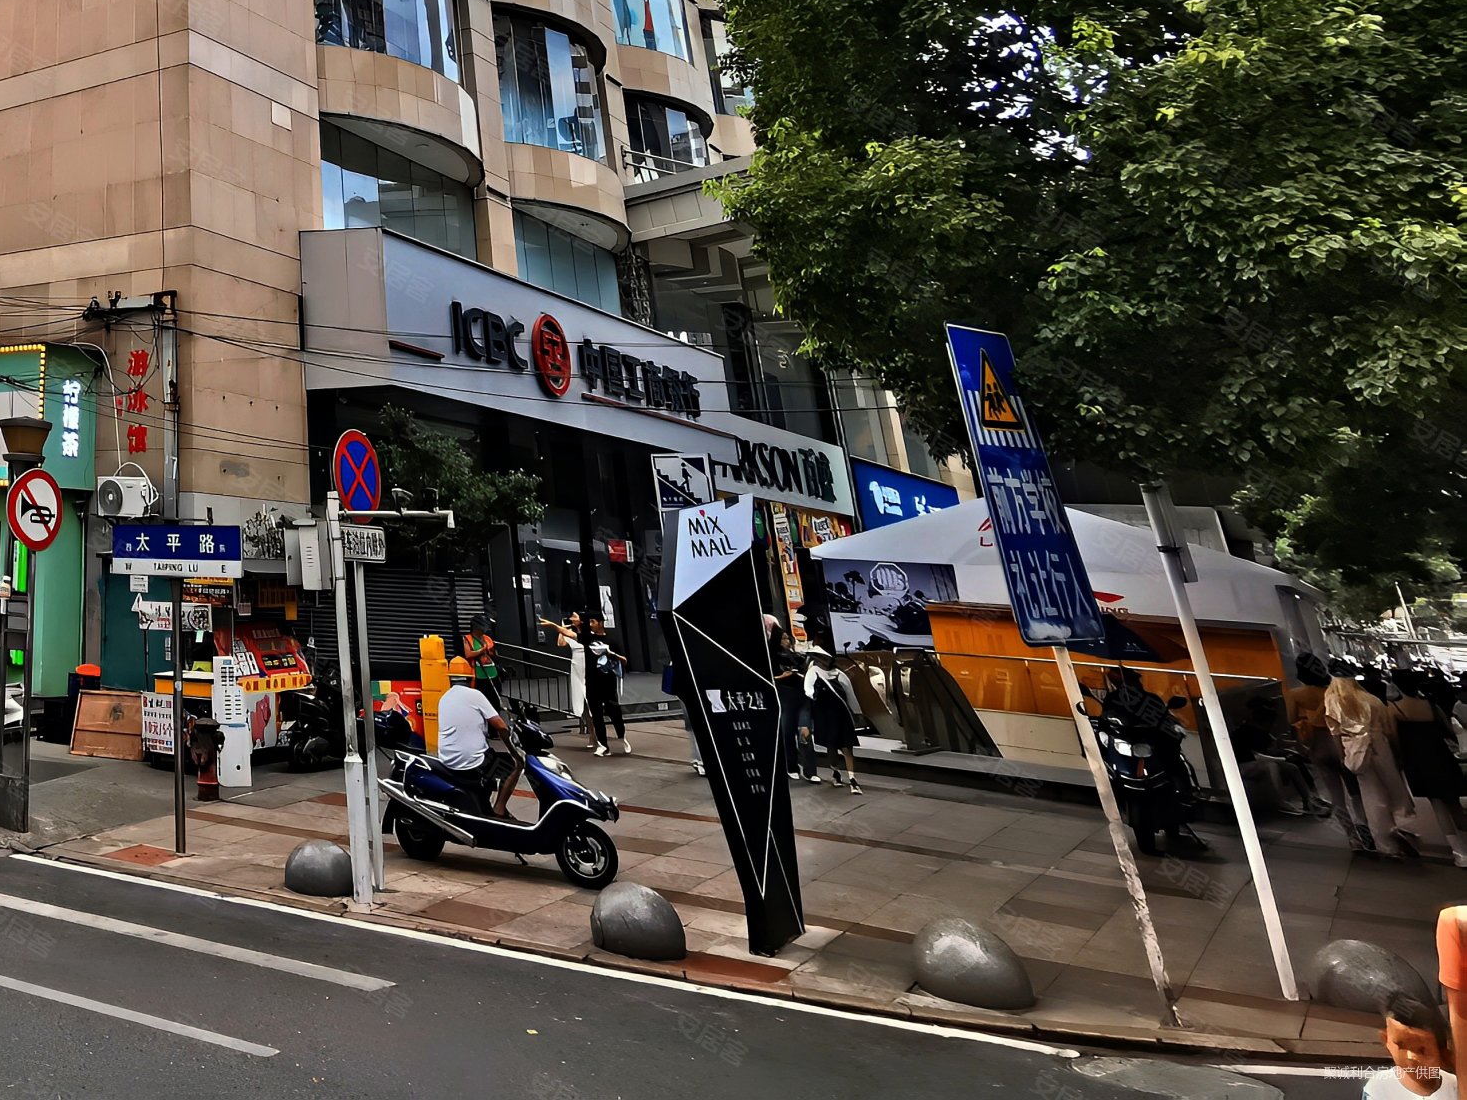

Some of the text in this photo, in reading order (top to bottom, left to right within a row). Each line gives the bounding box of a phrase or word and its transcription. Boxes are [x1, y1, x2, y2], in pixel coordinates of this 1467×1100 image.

[449, 300, 529, 370] ICBC
[987, 467, 1066, 535] 前方学校
[135, 533, 216, 554] 太平路
[691, 535, 738, 560] MALL
[153, 563, 183, 573] TAIPING
[188, 563, 199, 573] LU
[221, 564, 227, 574] E
[1009, 550, 1093, 619] 礼让行人
